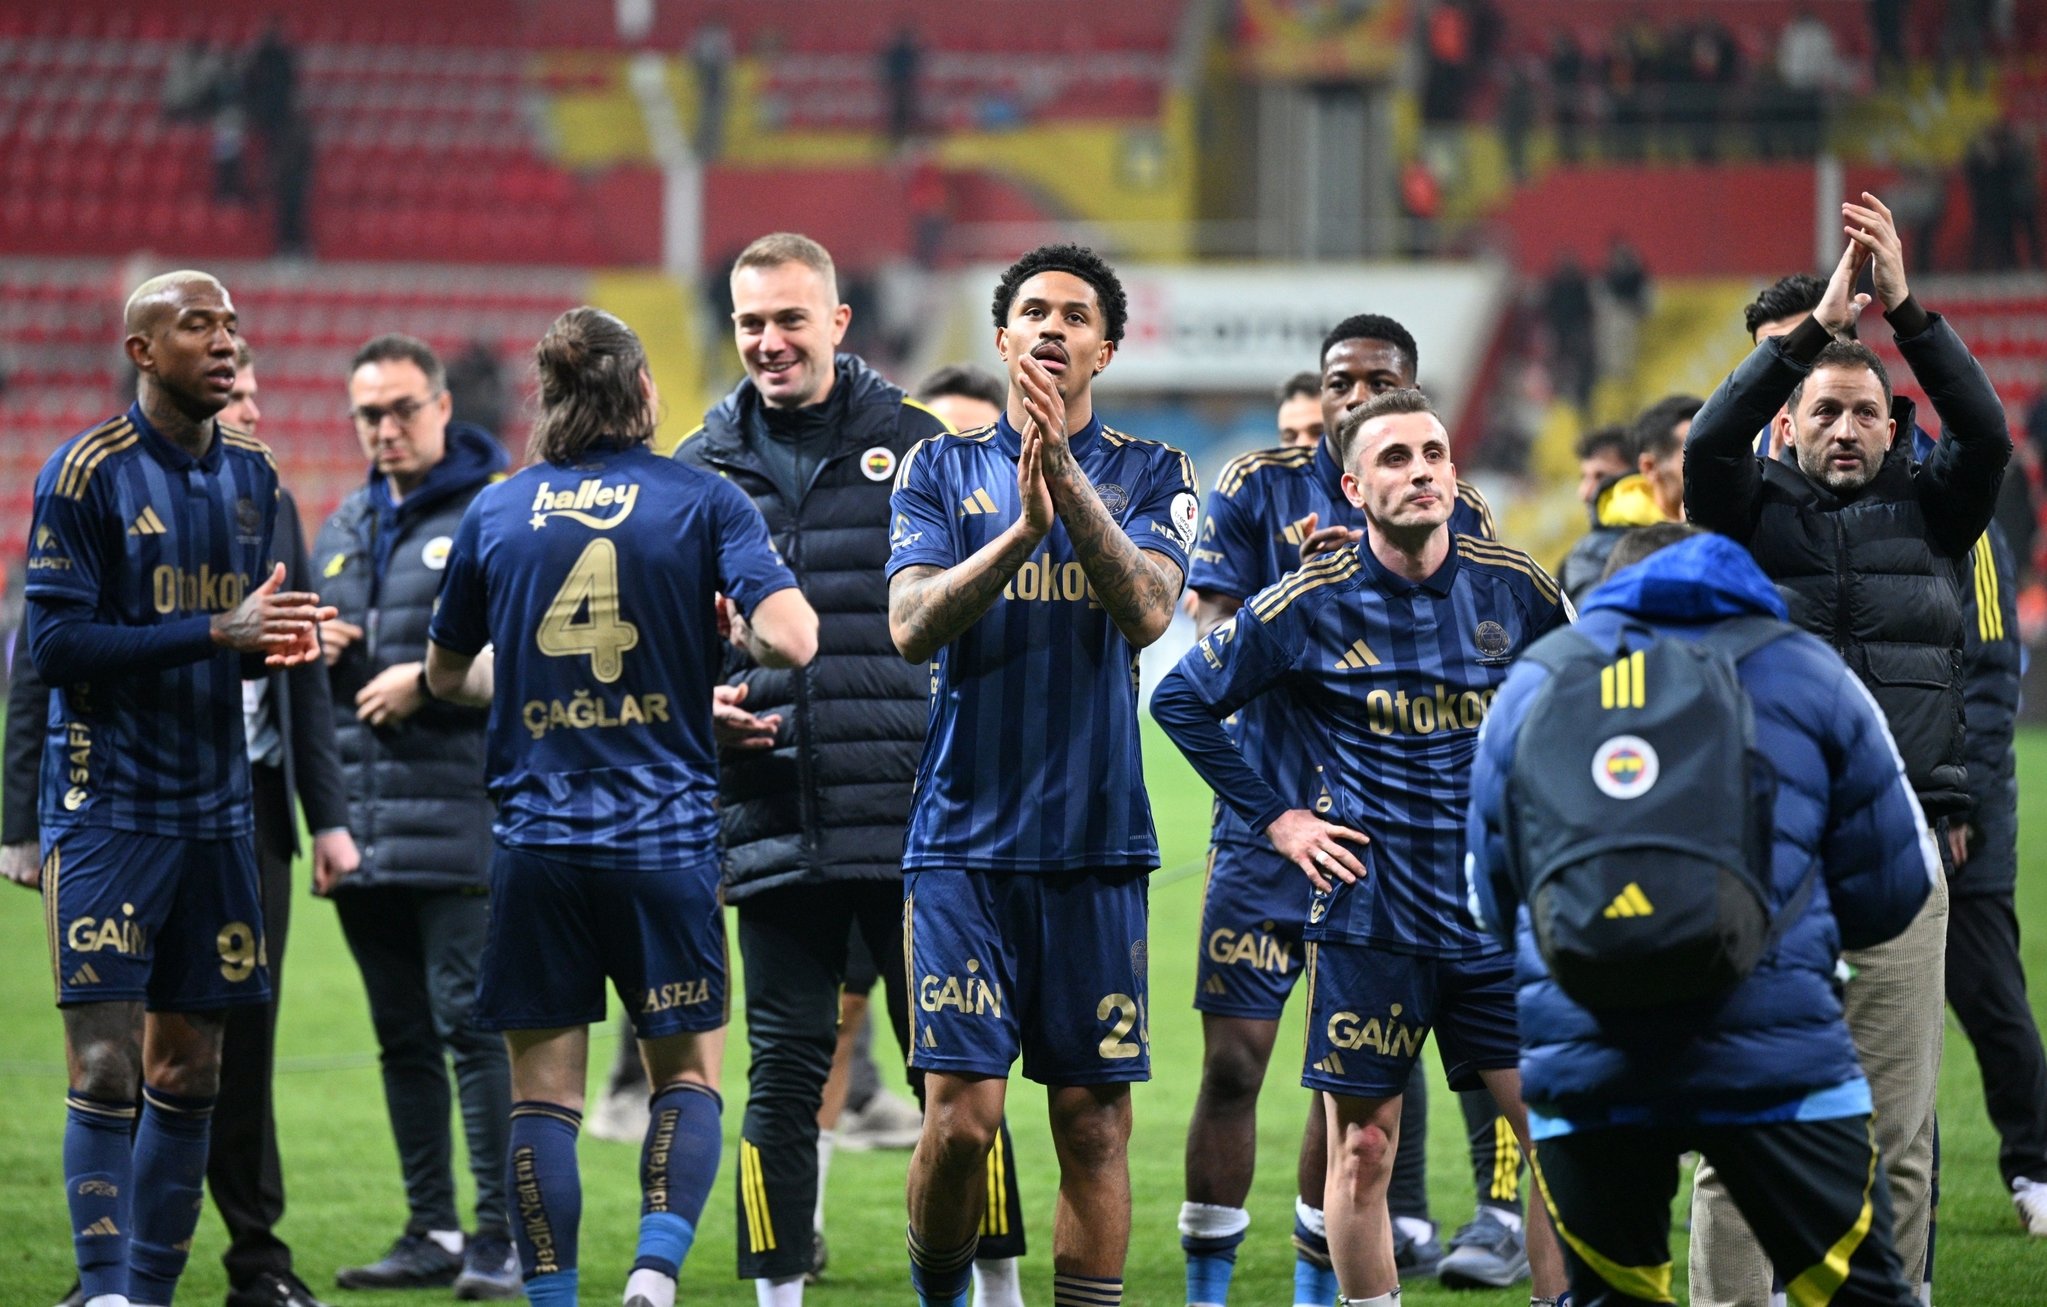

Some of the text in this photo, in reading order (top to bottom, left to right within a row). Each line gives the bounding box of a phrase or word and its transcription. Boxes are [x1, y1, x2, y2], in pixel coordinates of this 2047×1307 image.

[530, 480, 639, 530] halley
[1003, 552, 1102, 609] oko
[1195, 551, 1224, 564] PET
[536, 537, 639, 684] 4
[1200, 634, 1223, 670] PET
[522, 689, 670, 740] ÇAĞLAR
[216, 921, 268, 983] 9
[640, 977, 710, 1013] ASHA
